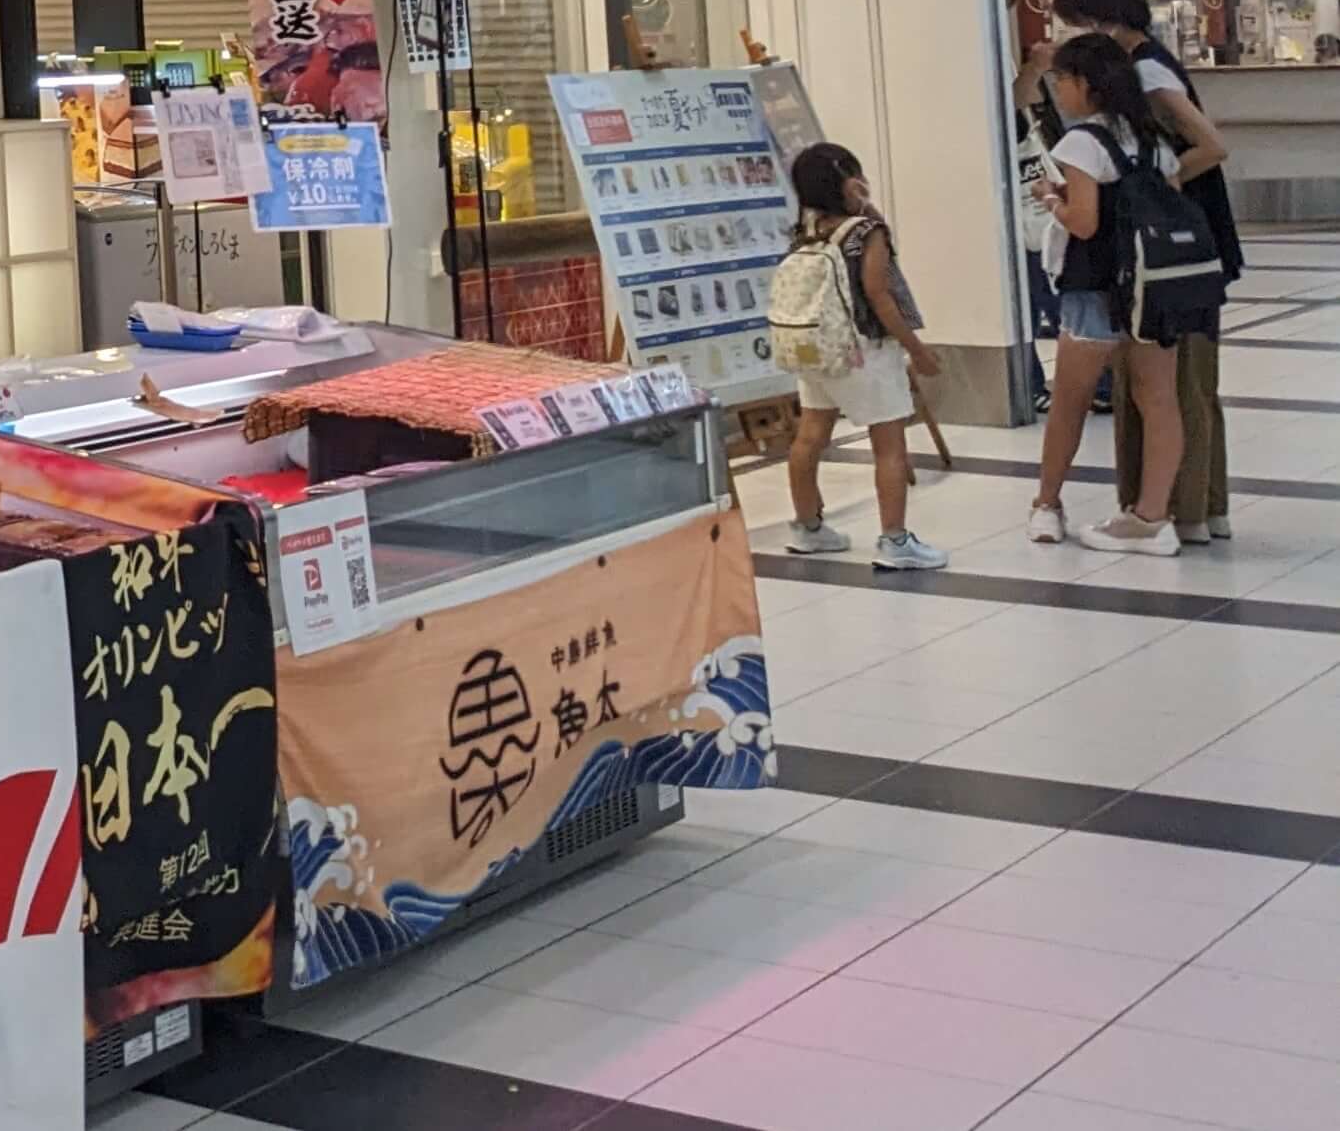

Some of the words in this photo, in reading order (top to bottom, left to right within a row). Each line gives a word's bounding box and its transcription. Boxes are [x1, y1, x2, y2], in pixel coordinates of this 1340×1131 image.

[82, 684, 274, 851] 日本一
[551, 670, 620, 758] 魚太
